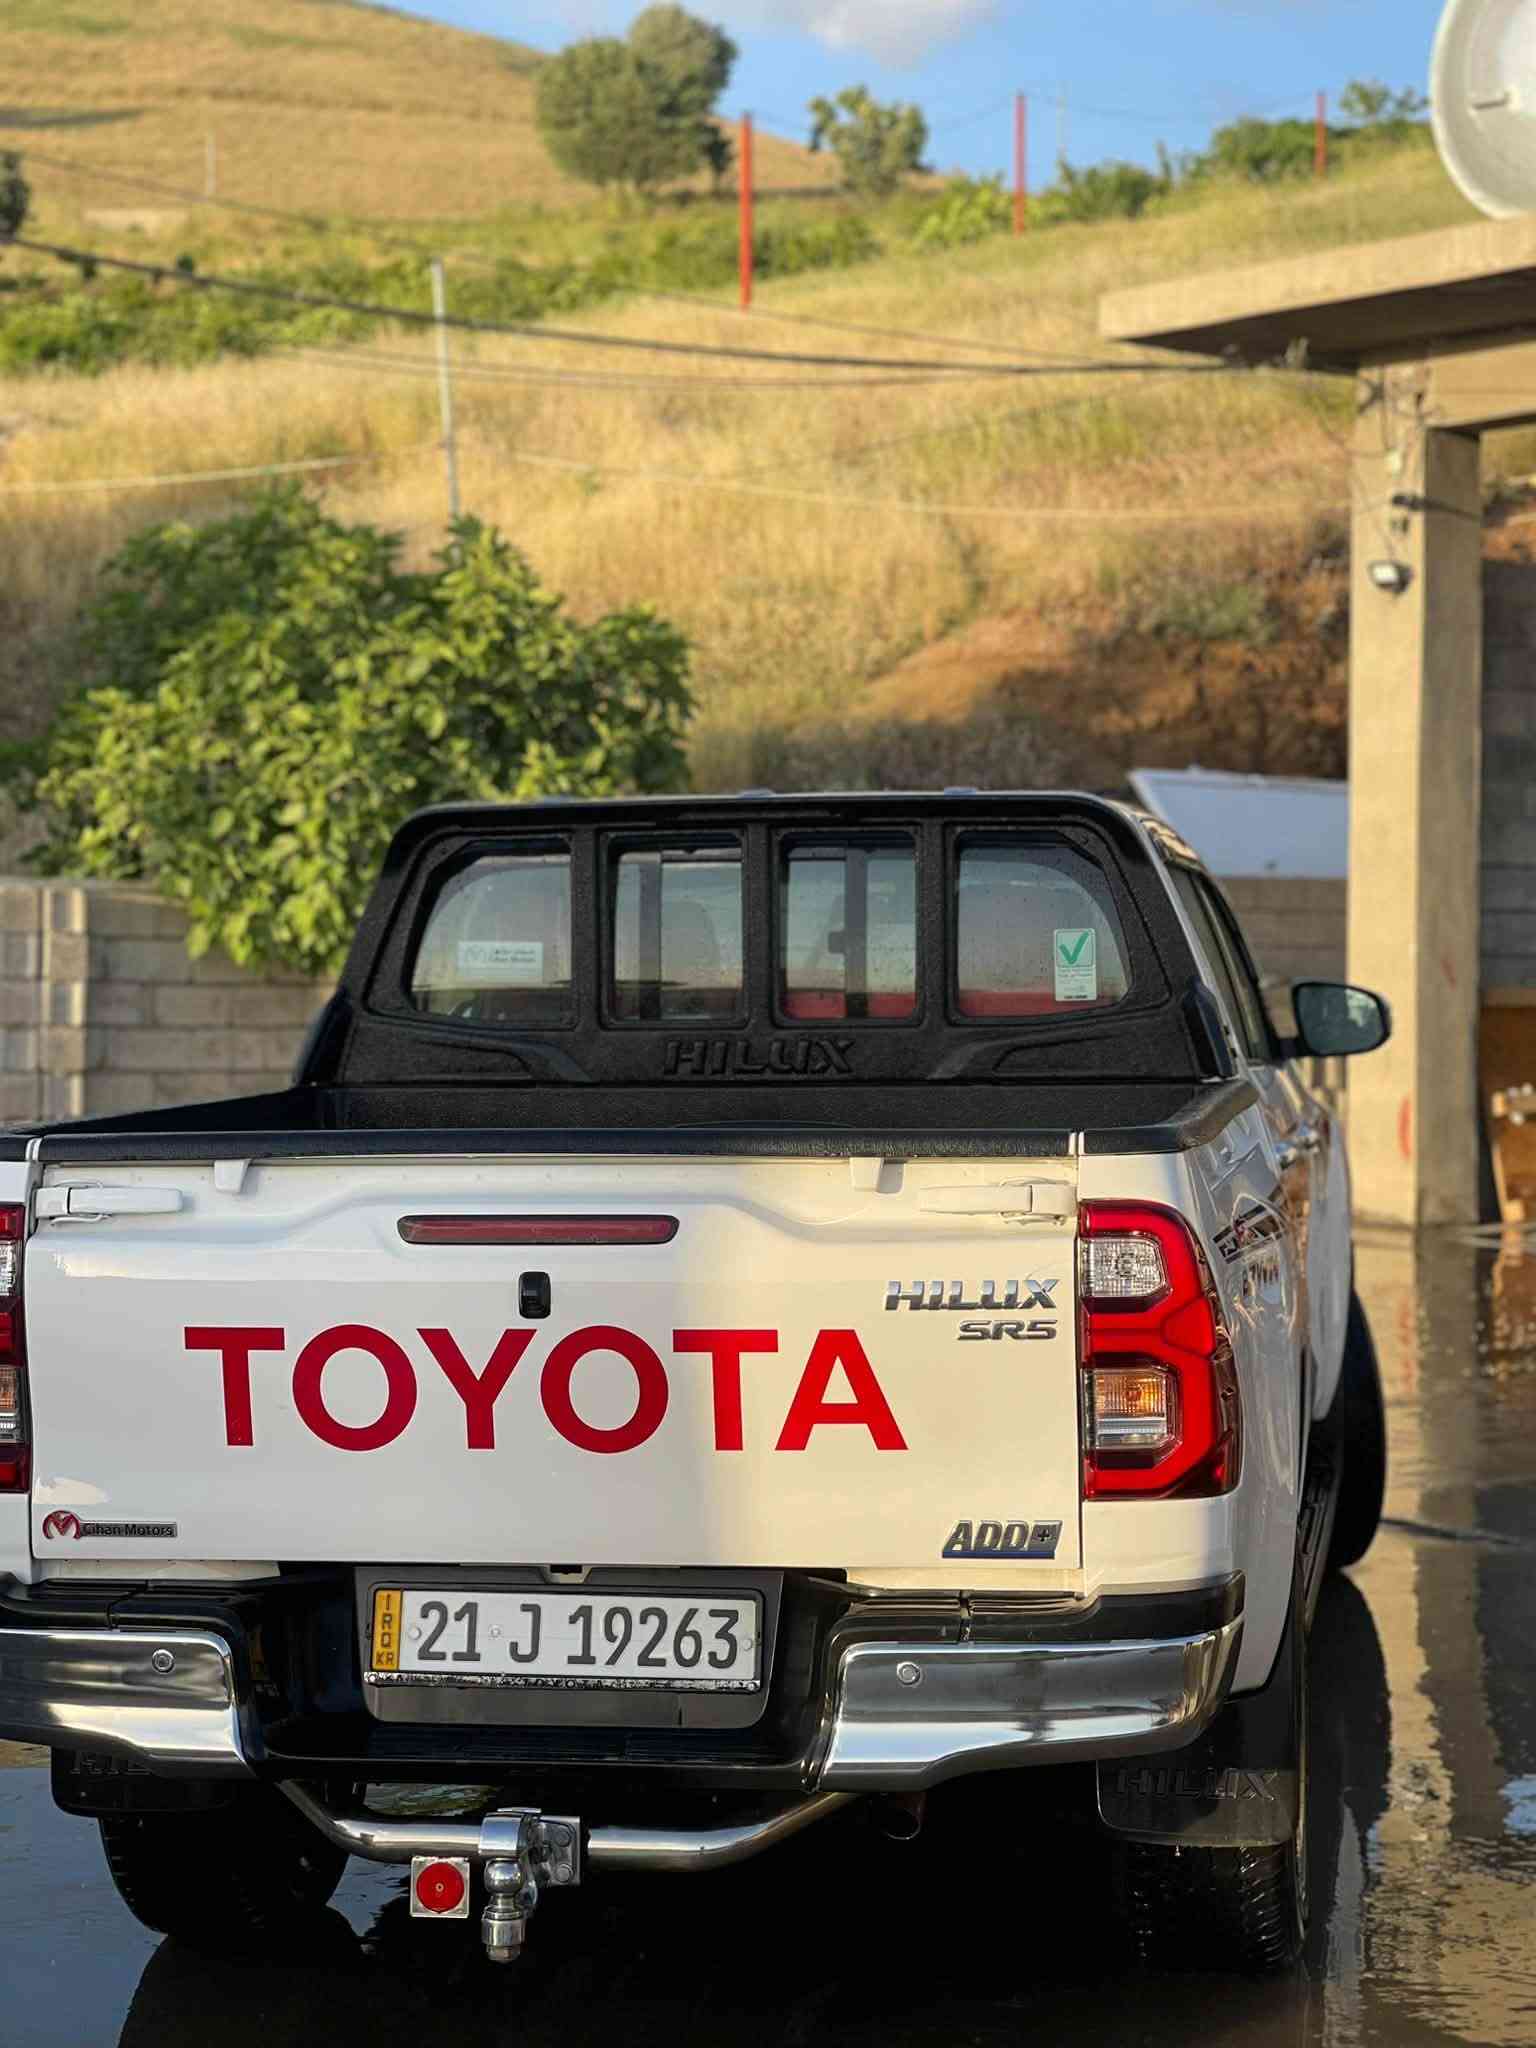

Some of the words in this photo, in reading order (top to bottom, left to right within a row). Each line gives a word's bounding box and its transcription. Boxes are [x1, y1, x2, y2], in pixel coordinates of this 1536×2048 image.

[664, 1038, 856, 1078] HILUX
[885, 1279, 1059, 1312] HILUX
[957, 1319, 1058, 1341] SR5
[184, 1325, 908, 1453] TOYOTA
[82, 1522, 121, 1537] Cihan
[124, 1523, 174, 1537] Motors
[417, 1600, 482, 1663] 21
[508, 1602, 542, 1664] J
[567, 1604, 740, 1669] 19263
[1115, 1767, 1279, 1801] HILUX
